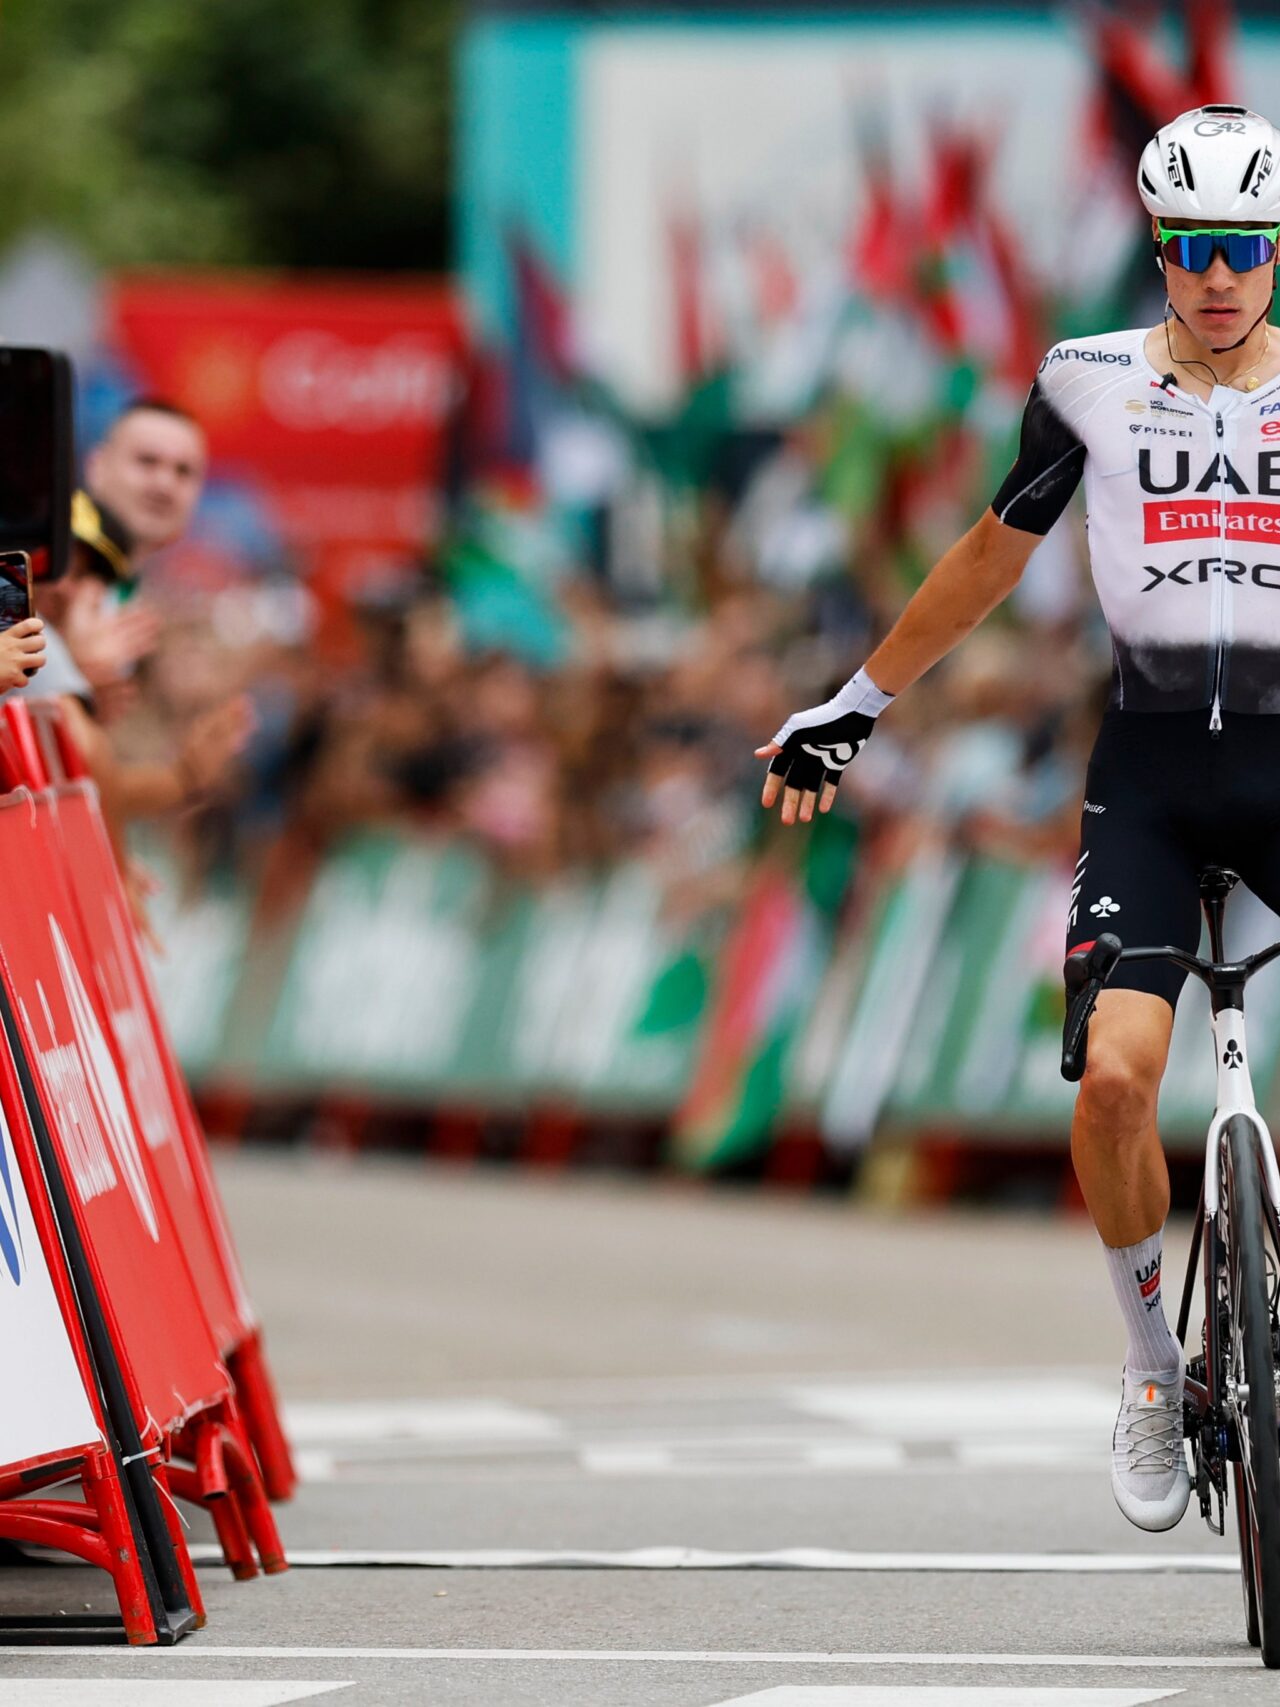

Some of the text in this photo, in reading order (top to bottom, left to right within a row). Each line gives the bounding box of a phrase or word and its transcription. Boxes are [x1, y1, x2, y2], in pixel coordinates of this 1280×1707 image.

[1194, 121, 1246, 137] G42
[1167, 141, 1184, 192] MET
[1250, 145, 1272, 198] MET
[1049, 348, 1131, 366] Analog
[1144, 426, 1193, 437] PISSEI
